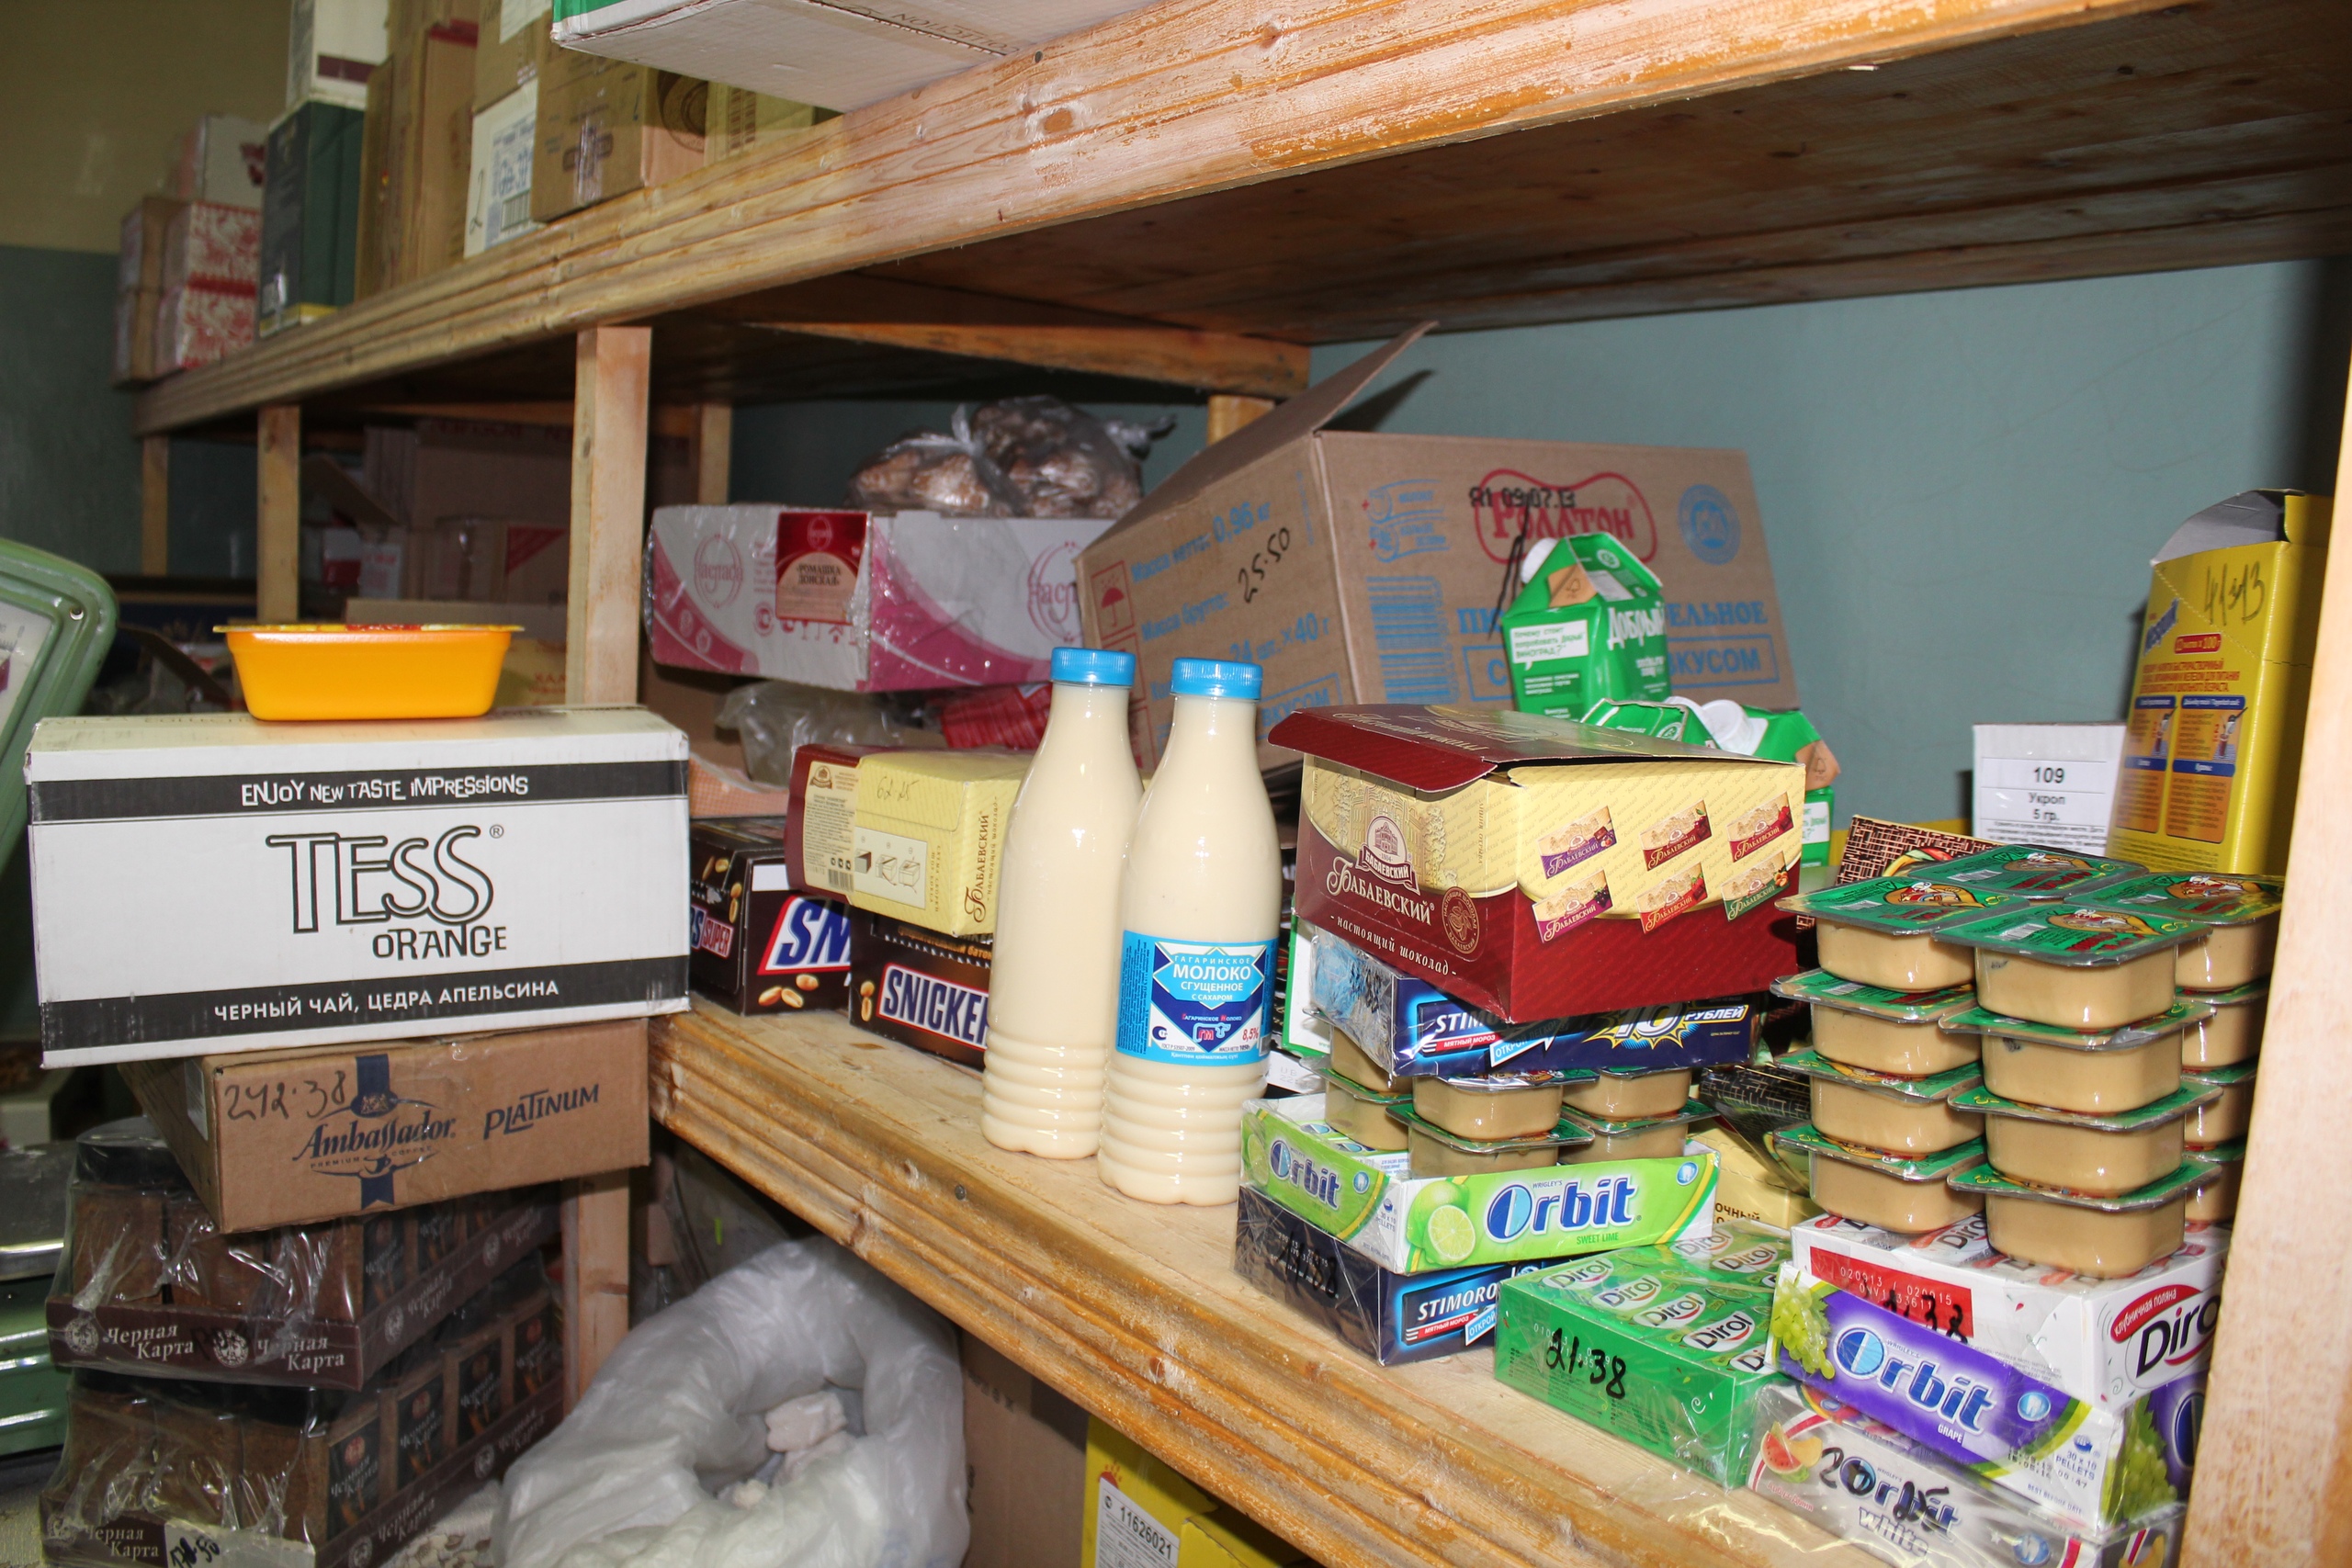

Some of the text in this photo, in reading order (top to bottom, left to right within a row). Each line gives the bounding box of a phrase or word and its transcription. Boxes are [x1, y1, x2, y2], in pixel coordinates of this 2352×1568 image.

[2033, 767, 2064, 784] 109
[310, 784, 344, 804] NEW
[347, 780, 406, 801] TASTE
[2028, 792, 2065, 807] Укроп
[2032, 808, 2040, 819] 5
[1364, 849, 1409, 880] БАБАЕВСКИЙ
[266, 825, 493, 934] TESS
[372, 924, 507, 961] ORANGE
[702, 918, 732, 957] SUPER
[1337, 915, 1450, 976] настоящий шоколад
[1173, 964, 1251, 981] МОЛОКО
[1174, 956, 1250, 964] ГАГАРИНСКОЕ
[1181, 981, 1243, 992] СГУЩЕННОЕ
[214, 980, 560, 1021] ЧЕРНЫЙ ЧАЙ, ЦЕДРА АПЕЛЬСИНА
[1684, 1006, 1746, 1022] РУБЛЕЙ
[1443, 1034, 1496, 1047] МЯТНЫЙ МОРОЗ
[483, 1083, 600, 1141] PLATINUM
[1270, 1139, 1340, 1210] Orbit
[1532, 1179, 1563, 1190] WRIGLEY'S
[1487, 1176, 1637, 1240] Orbit
[1576, 1232, 1619, 1246] SWEET LIME
[1675, 1228, 1733, 1256] Dirol
[1718, 1243, 1777, 1271] Dirol
[1553, 1259, 1612, 1288] Dirol
[1599, 1277, 1661, 1308] Dirol
[1647, 1293, 1706, 1326] Dirol
[2114, 1288, 2177, 1337] клубничная поляна
[107, 1325, 179, 1345] Черная
[1424, 1315, 1469, 1334] МЯТНЫЙ МОРОЗ
[1691, 1312, 1753, 1348] Dirol
[138, 1340, 194, 1362] Карта
[288, 1352, 346, 1375] Карта
[1837, 1327, 1993, 1432] Orbit
[1938, 1424, 1964, 1444] GRAPE
[2055, 1455, 2095, 1481] PELLETS
[2067, 1450, 2077, 1461] 30
[2027, 1483, 2042, 1495] BEST
[1120, 1506, 1171, 1561] 11626021
[1860, 1506, 1929, 1557] white
[111, 1540, 160, 1562] Карта
